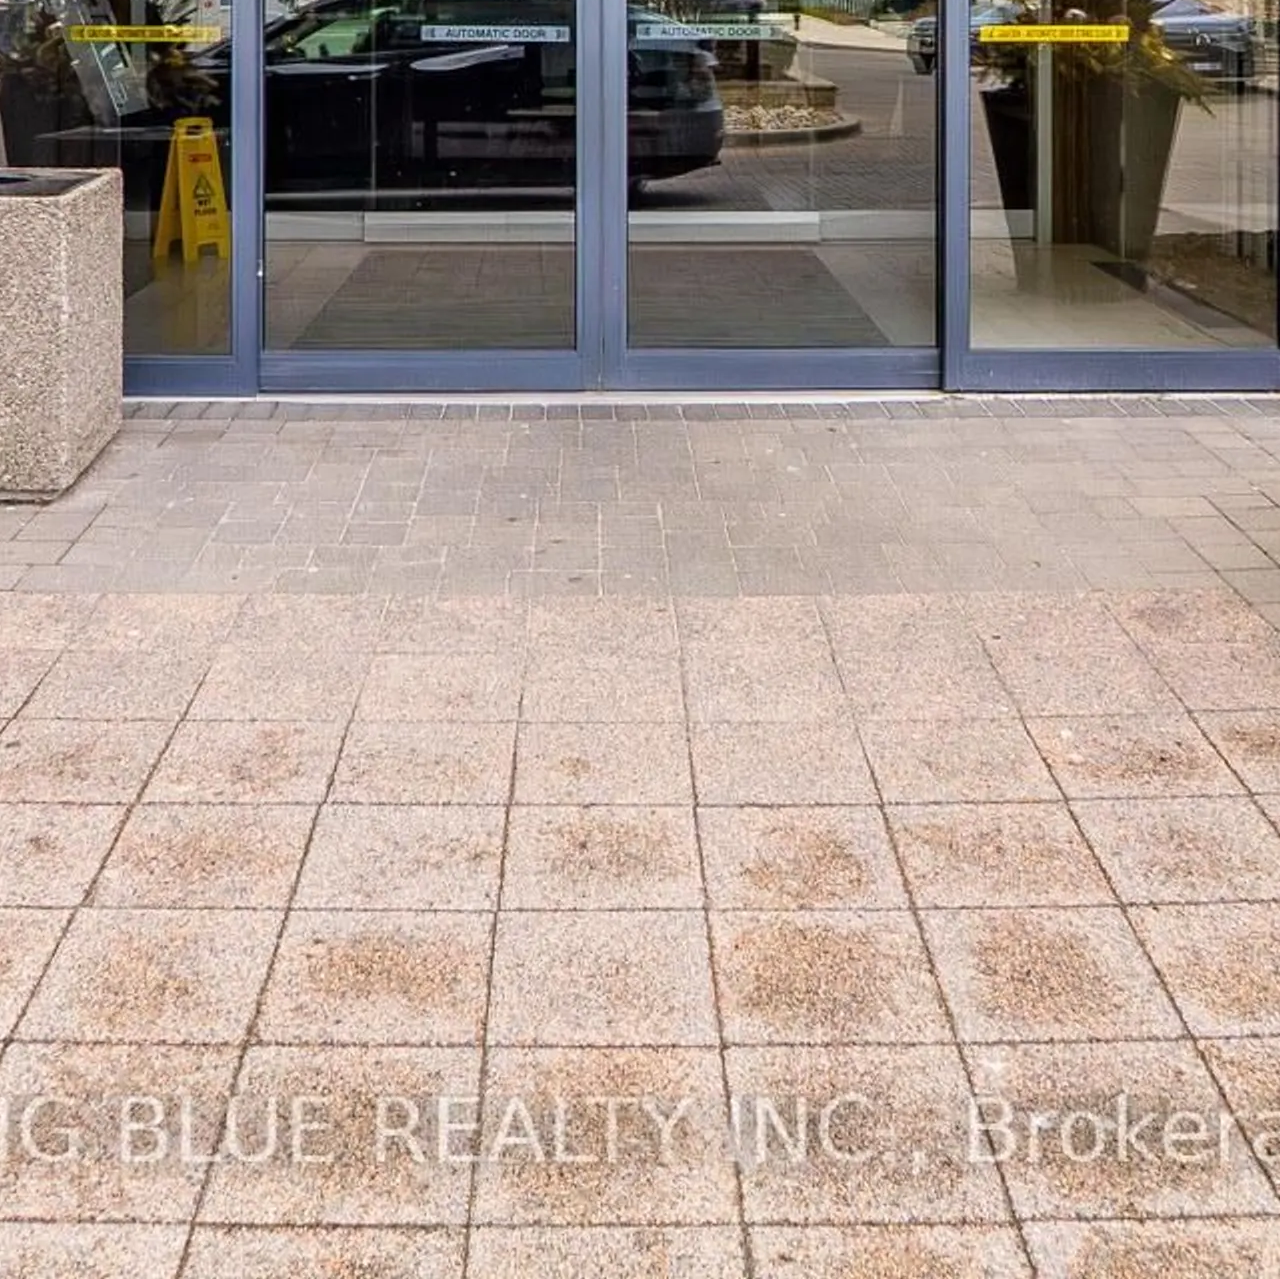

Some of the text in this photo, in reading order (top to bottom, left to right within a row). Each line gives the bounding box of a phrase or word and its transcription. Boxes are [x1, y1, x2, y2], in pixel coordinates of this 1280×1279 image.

[446, 28, 546, 38] AUTOMATIC DOOR
[728, 26, 761, 37] DOOR
